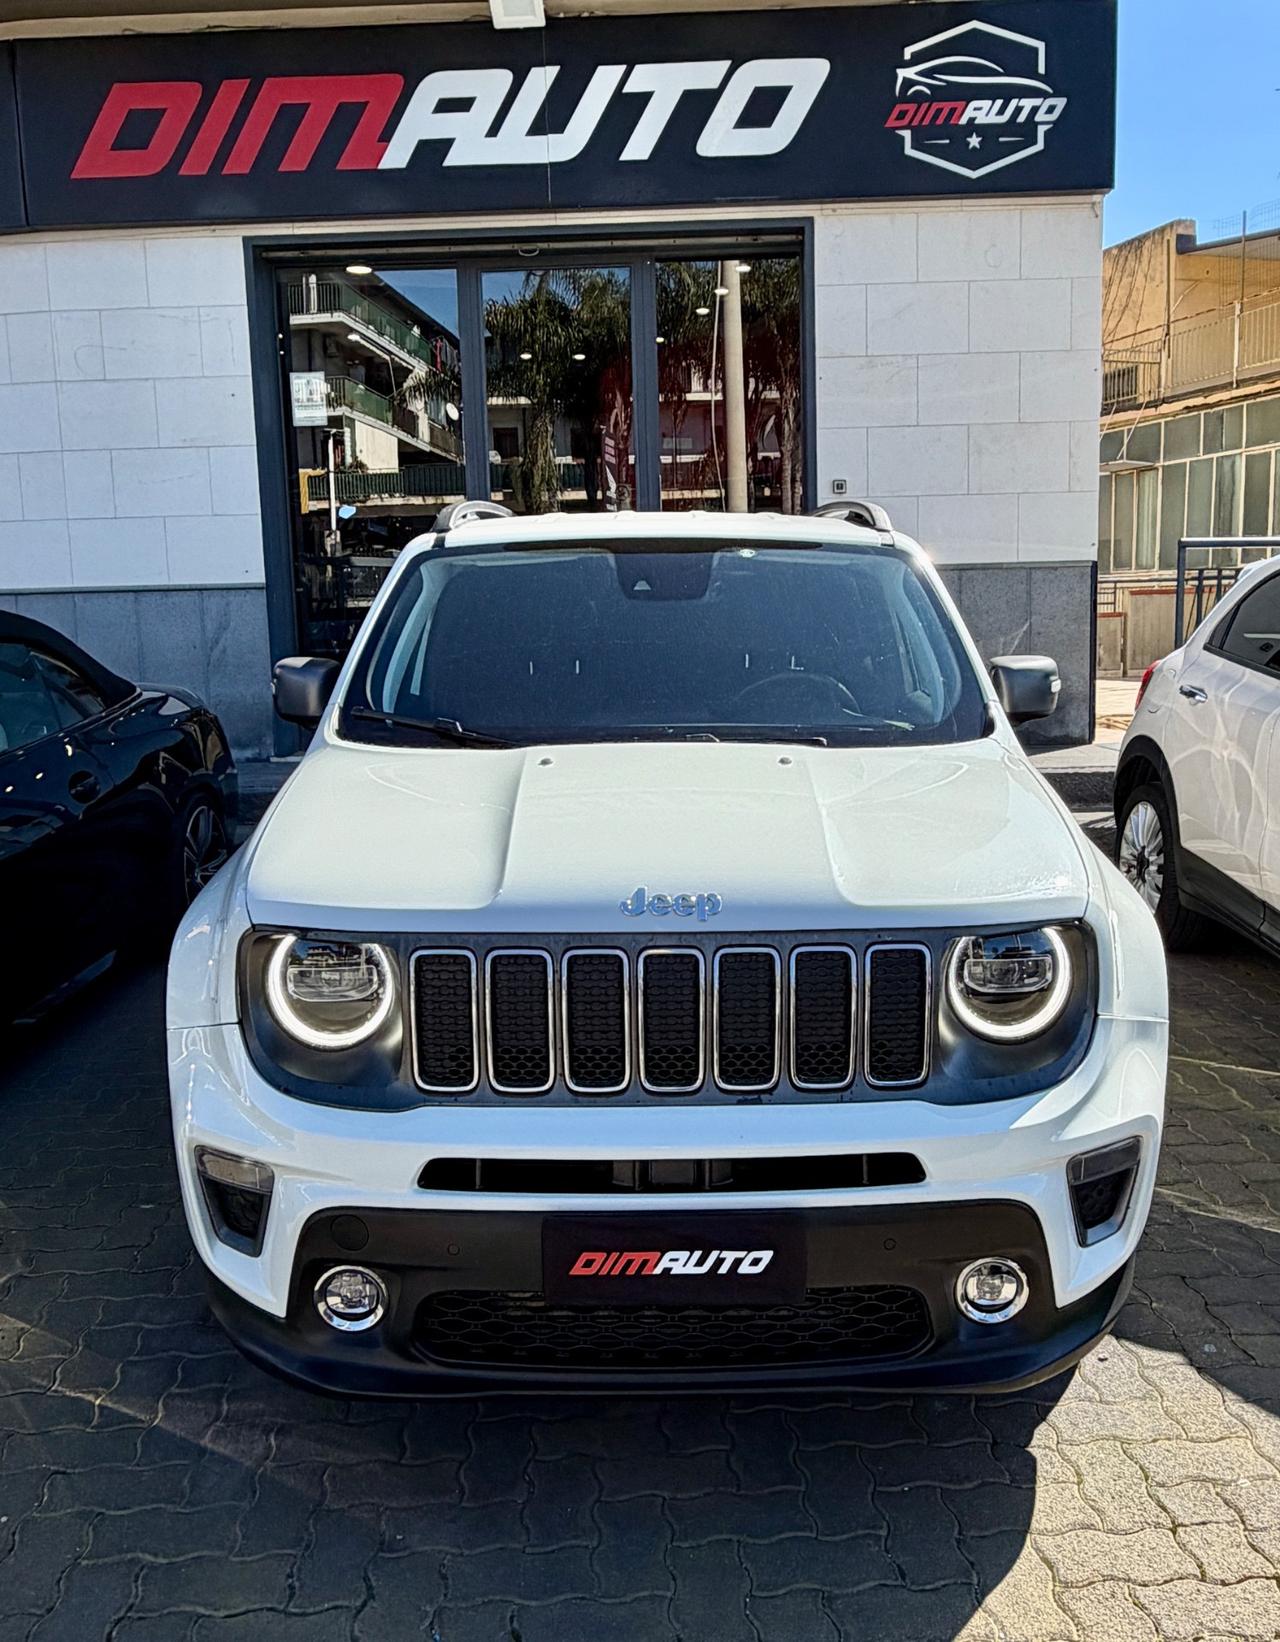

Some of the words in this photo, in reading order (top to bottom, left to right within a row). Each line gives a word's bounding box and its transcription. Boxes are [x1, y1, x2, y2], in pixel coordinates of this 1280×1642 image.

[71, 58, 831, 179] DIMAUTO
[884, 97, 1068, 128] DIMAUTO
[620, 886, 723, 921] Jeep
[568, 1250, 774, 1276] DIMAUTO
